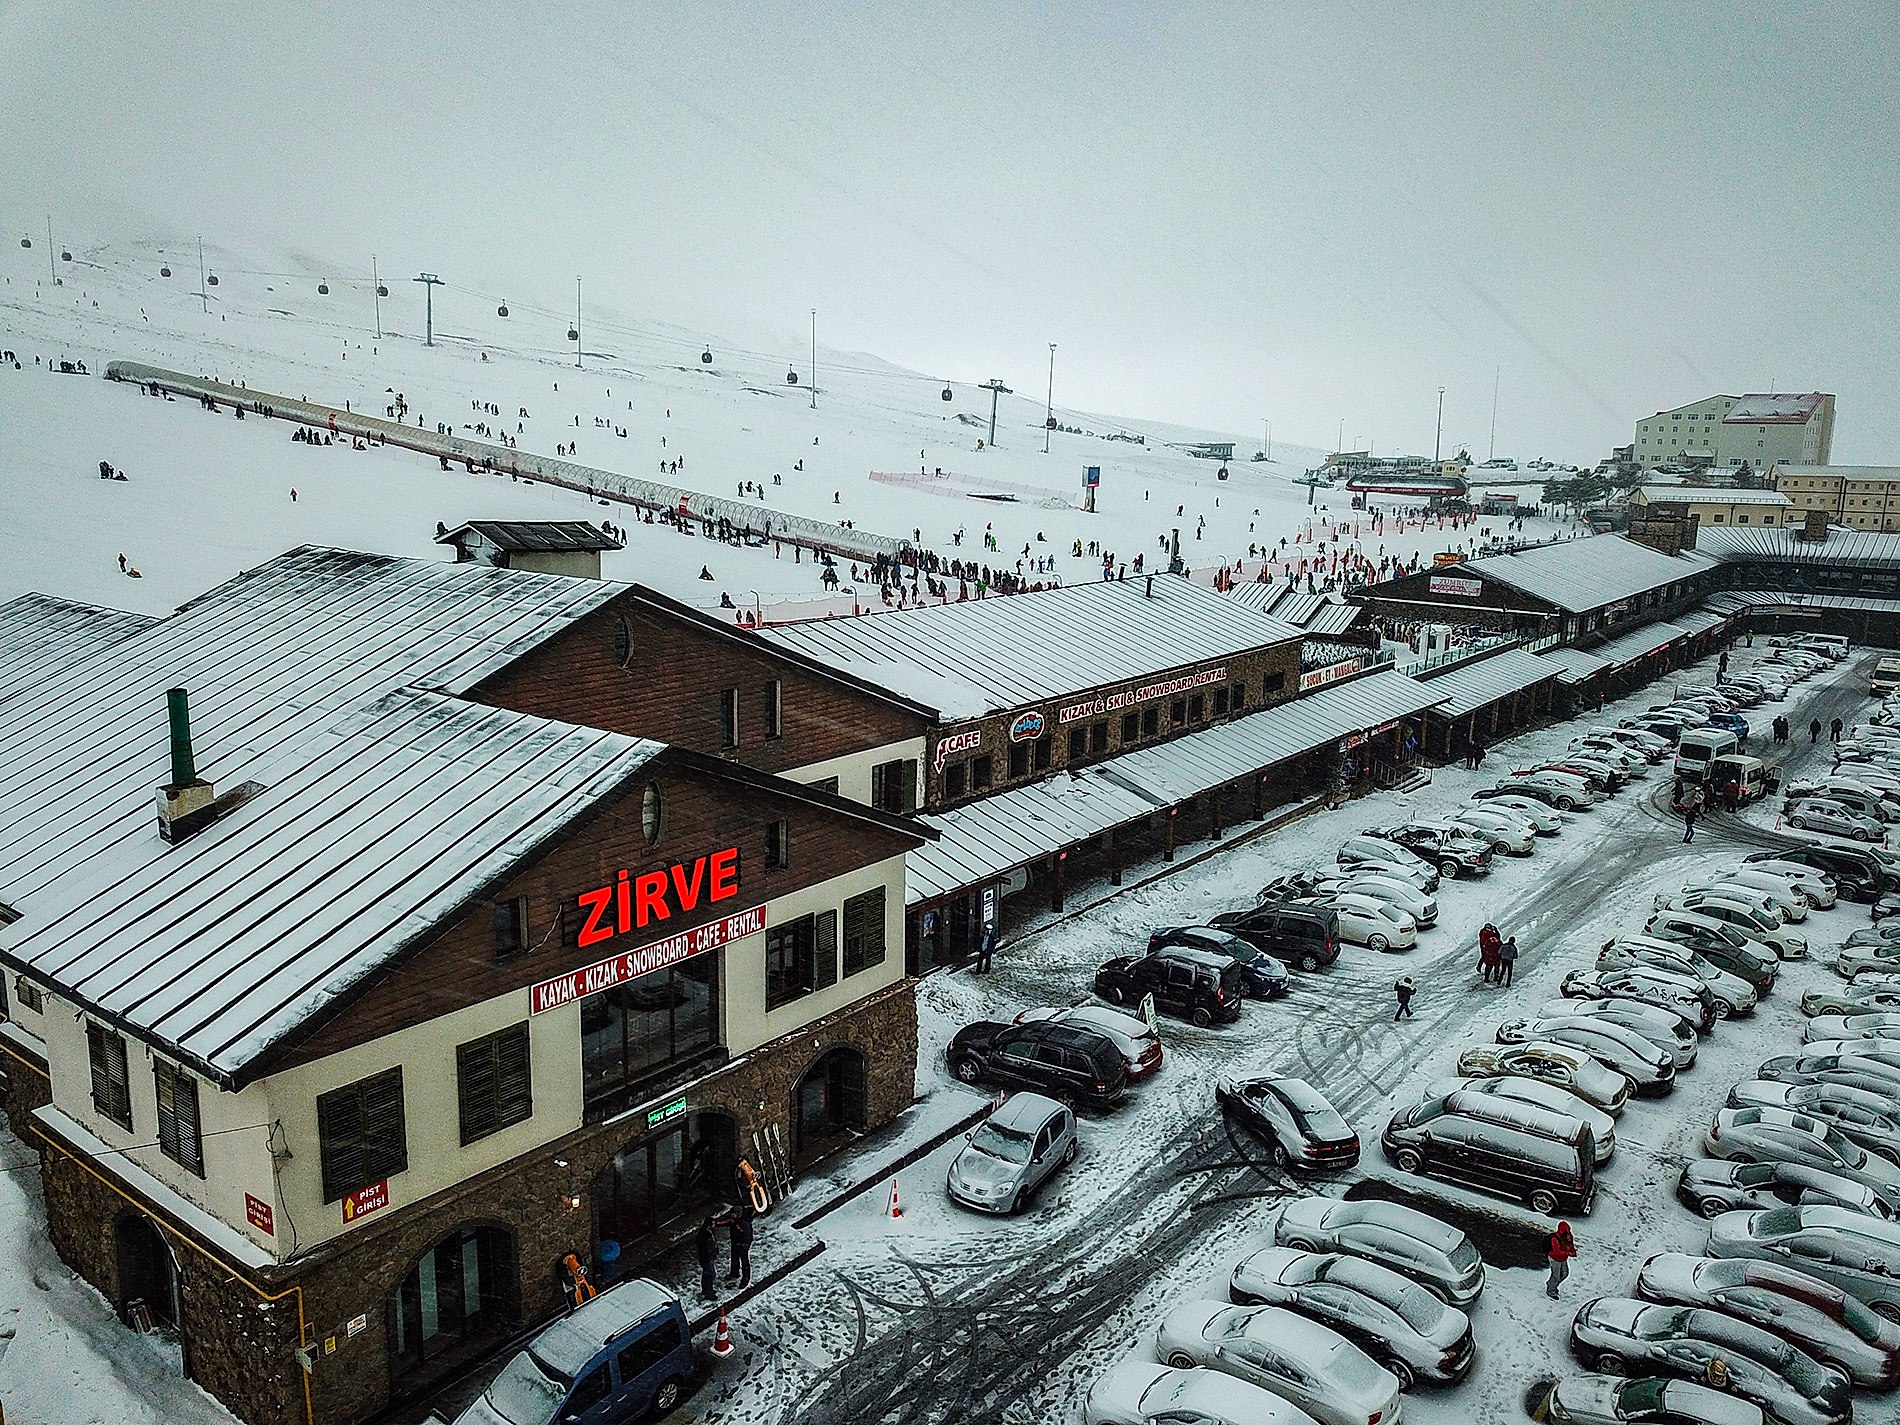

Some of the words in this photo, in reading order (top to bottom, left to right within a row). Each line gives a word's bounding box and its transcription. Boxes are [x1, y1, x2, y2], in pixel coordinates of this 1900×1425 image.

[1060, 701, 1094, 723] KIZAK
[1094, 699, 1105, 714] &
[1106, 693, 1125, 711] SKI
[1125, 690, 1135, 706] &
[1136, 675, 1195, 703] SNOWBOARD
[1194, 667, 1229, 688] RENTAL
[948, 730, 980, 753] CAFE
[578, 847, 738, 949] ZİRVE
[540, 975, 577, 1010] KAYAK
[585, 959, 619, 993] KIZAK
[626, 935, 689, 977] SNOWBOARD
[696, 923, 721, 952] CAFE
[727, 909, 762, 941] RENTAL
[356, 1193, 385, 1215] GİRİŞİ
[359, 1184, 381, 1201] PİST
